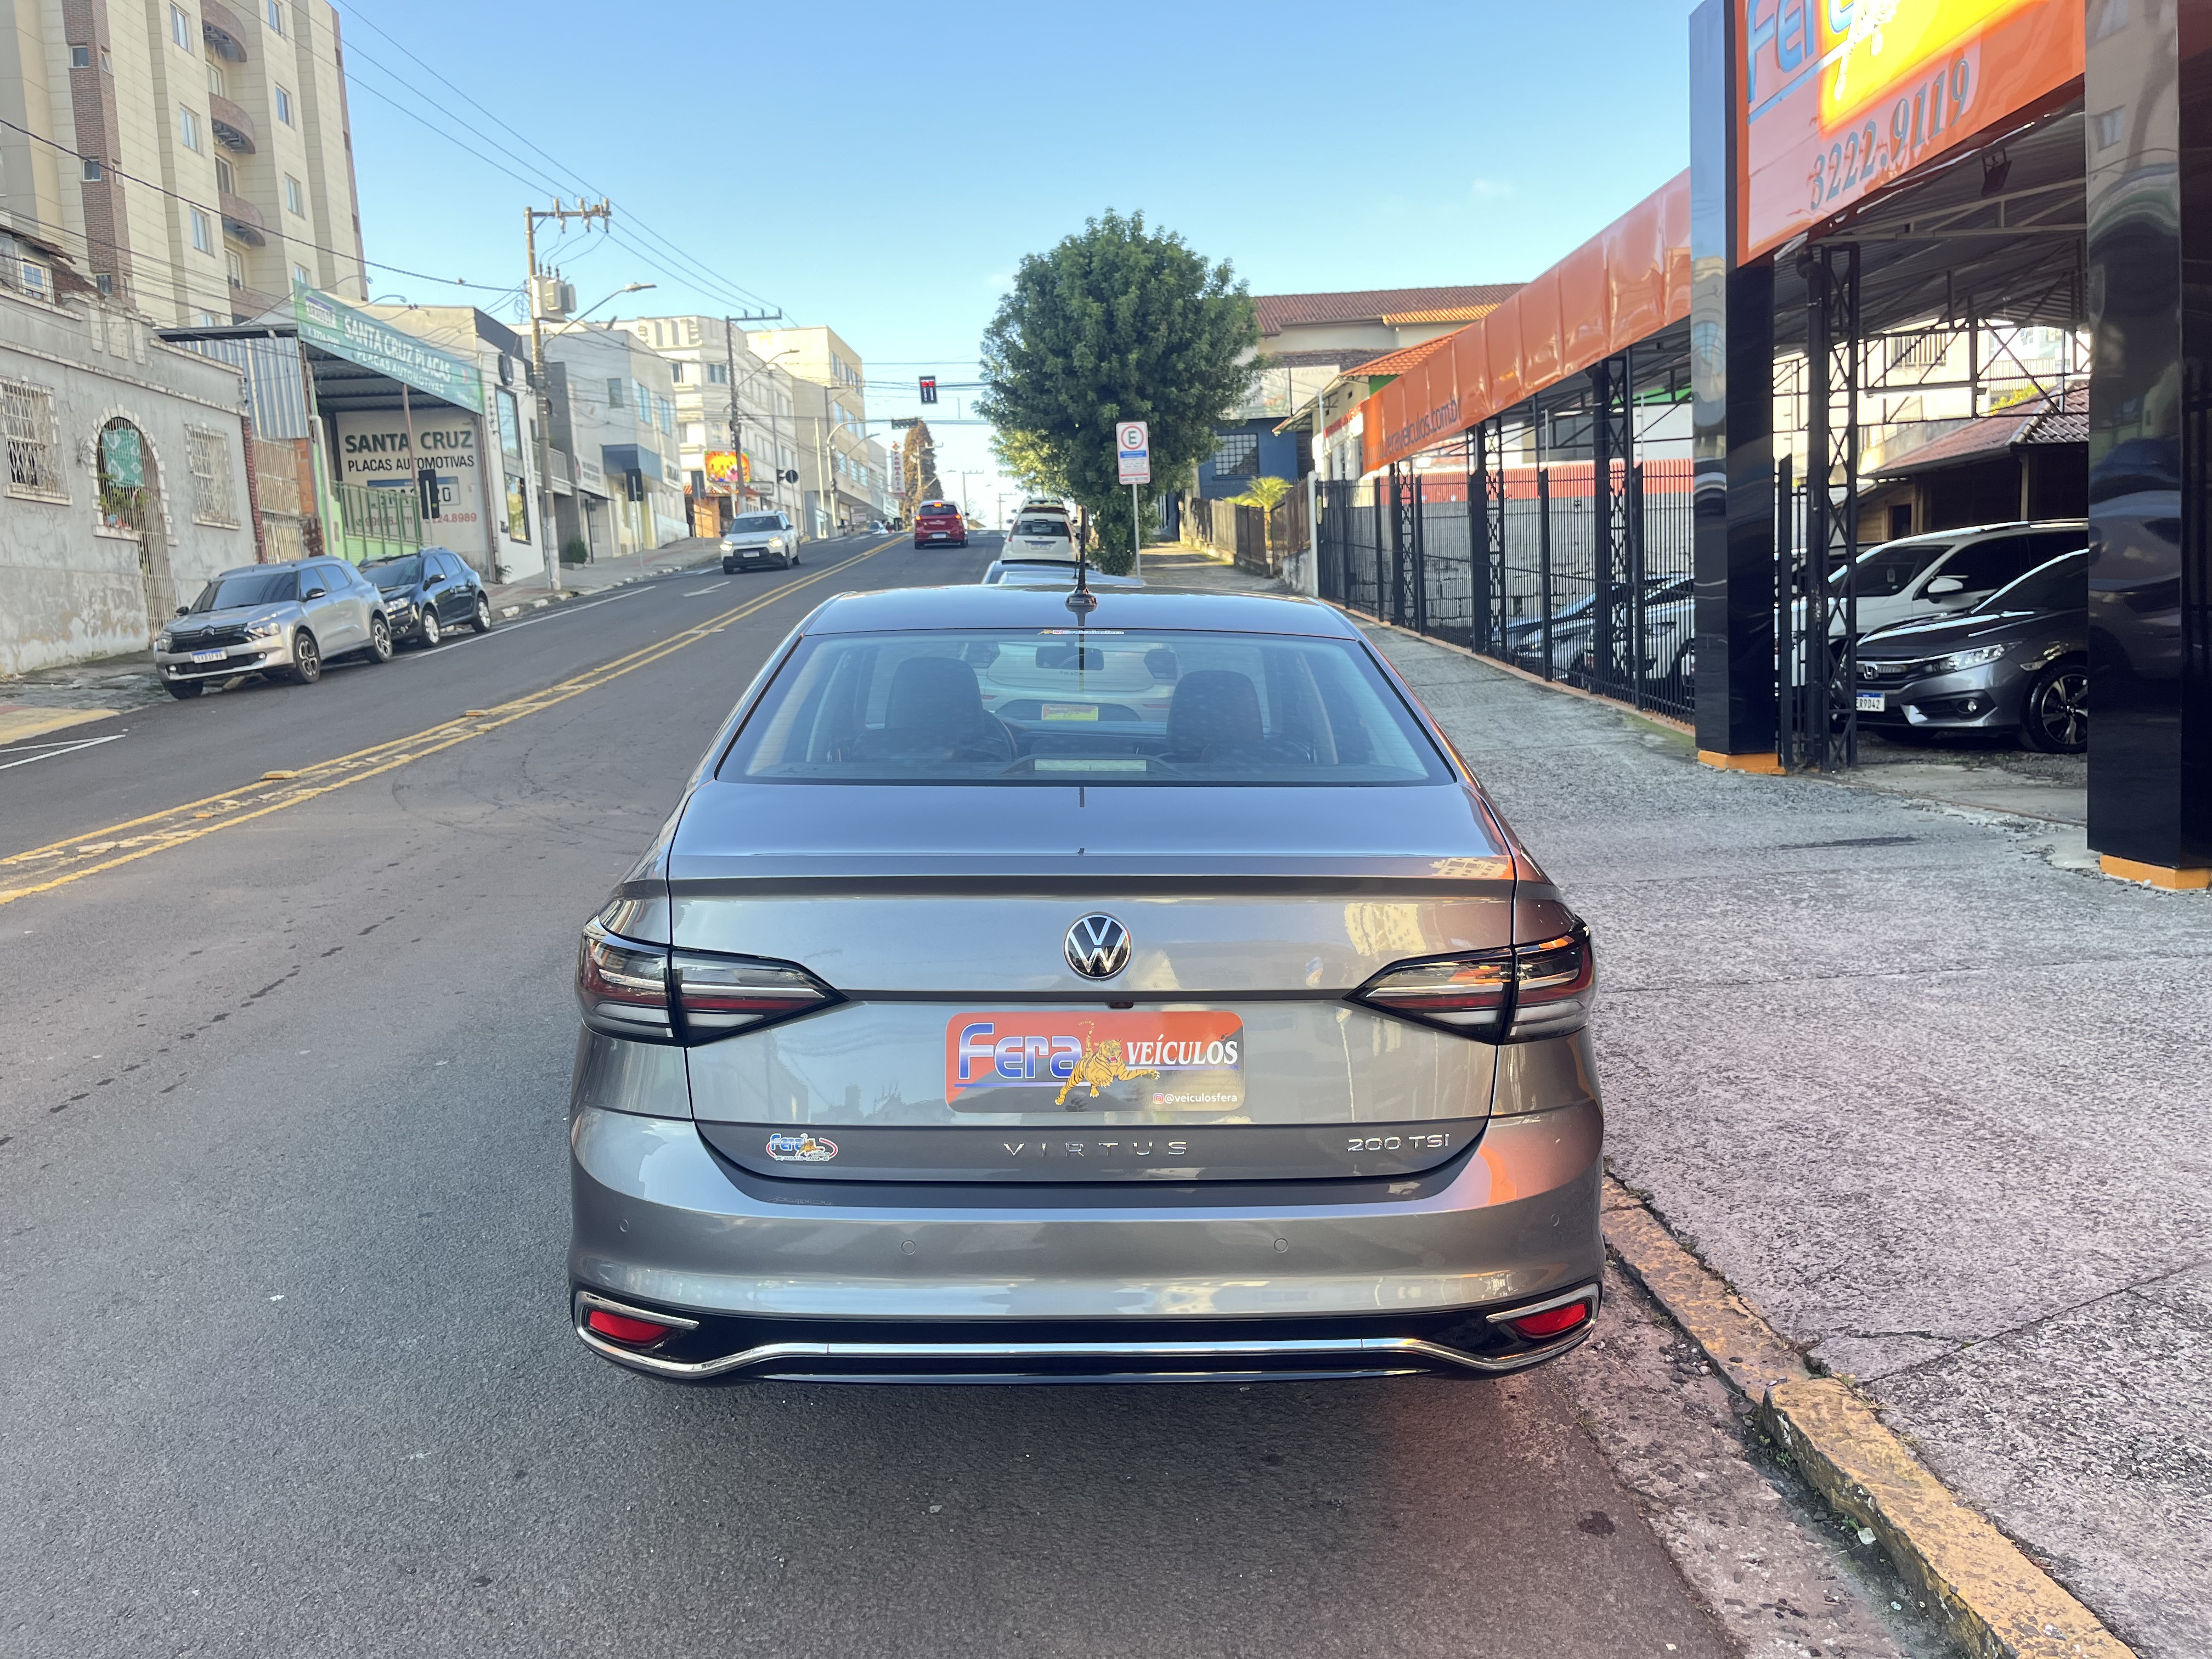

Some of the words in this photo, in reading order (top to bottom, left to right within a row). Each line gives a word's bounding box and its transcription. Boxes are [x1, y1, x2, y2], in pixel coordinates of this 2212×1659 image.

[1810, 58, 1971, 211] 3222.9119
[343, 315, 382, 353] SANTA
[384, 334, 413, 364] CRUZ
[415, 348, 452, 382] PLACAS
[357, 348, 390, 372] PLACAS
[391, 363, 445, 394] AUTOMOTIVAS
[345, 433, 410, 453] SANTA
[420, 430, 473, 449] CRUZ
[1128, 431, 1137, 445] E
[348, 459, 392, 472] PLACAS
[396, 455, 475, 470] AUOMOTIVAS
[424, 512, 477, 523] 24.8989
[958, 1022, 1082, 1080] Fera
[1126, 1034, 1238, 1065] VEÍCULOS
[1164, 1092, 1238, 1104] @veiculosfera
[770, 1133, 804, 1151] Fera
[1003, 1141, 1188, 1156] VIRTUS
[1347, 1136, 1401, 1152] 200
[1408, 1133, 1449, 1149] TSI
